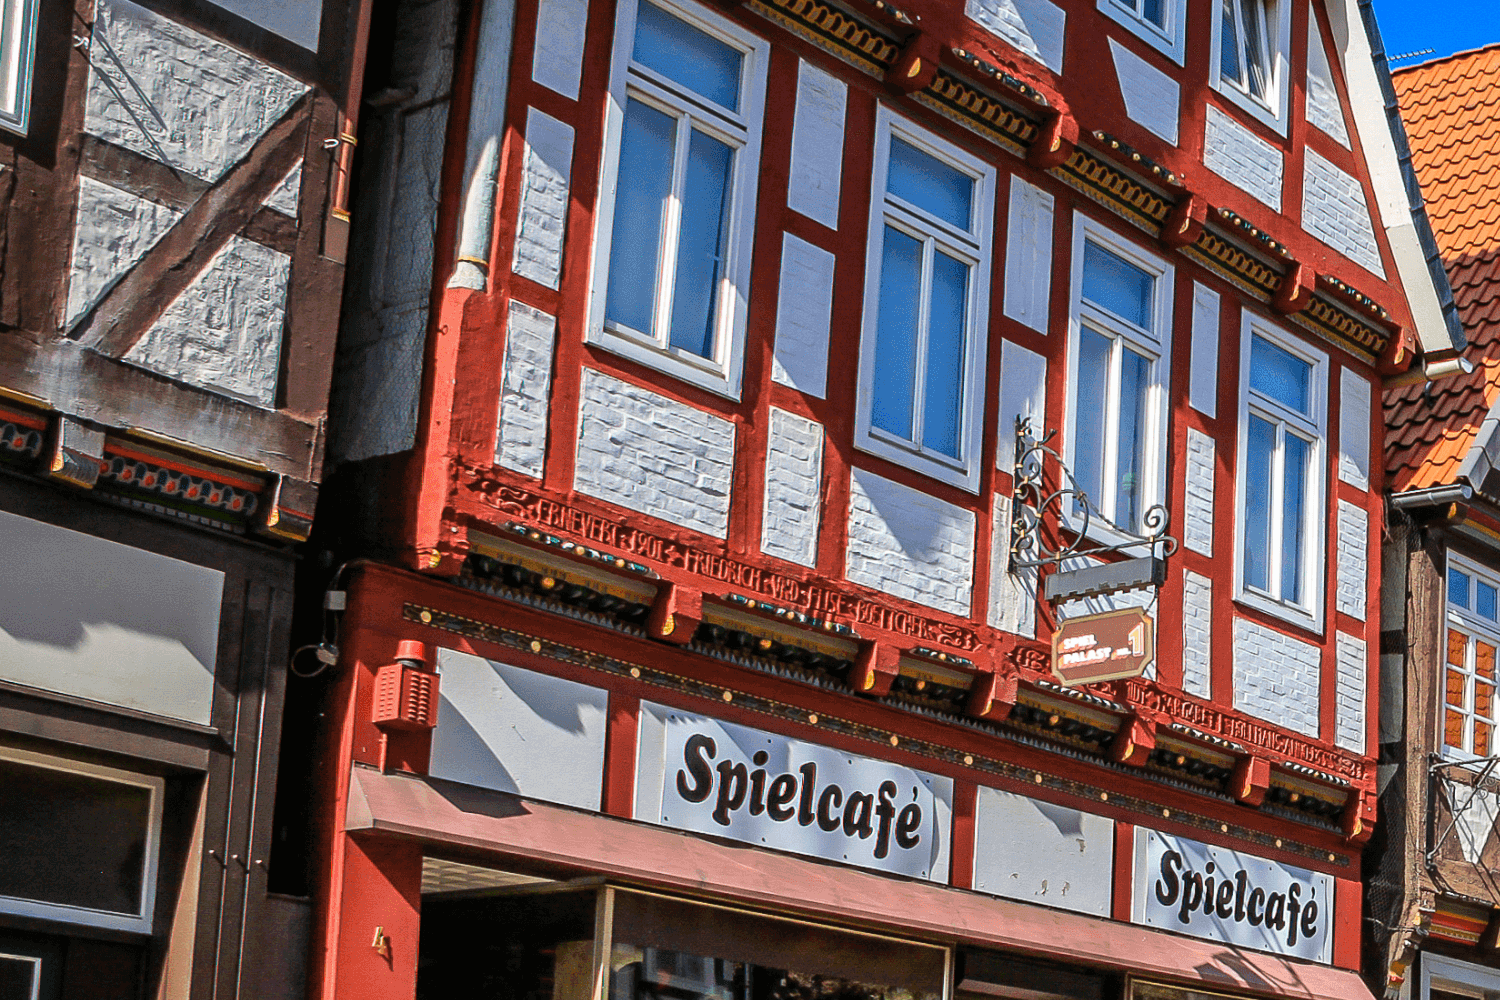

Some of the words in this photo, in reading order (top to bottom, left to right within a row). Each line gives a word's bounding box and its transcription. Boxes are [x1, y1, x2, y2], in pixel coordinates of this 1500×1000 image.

[683, 548, 761, 592] FRIEDRICH
[1060, 634, 1098, 652] SPIEL
[1060, 646, 1112, 668] PALAST
[1128, 621, 1145, 657] 1
[677, 733, 923, 858] Spielcafé
[1155, 850, 1319, 947] Spielcafé
